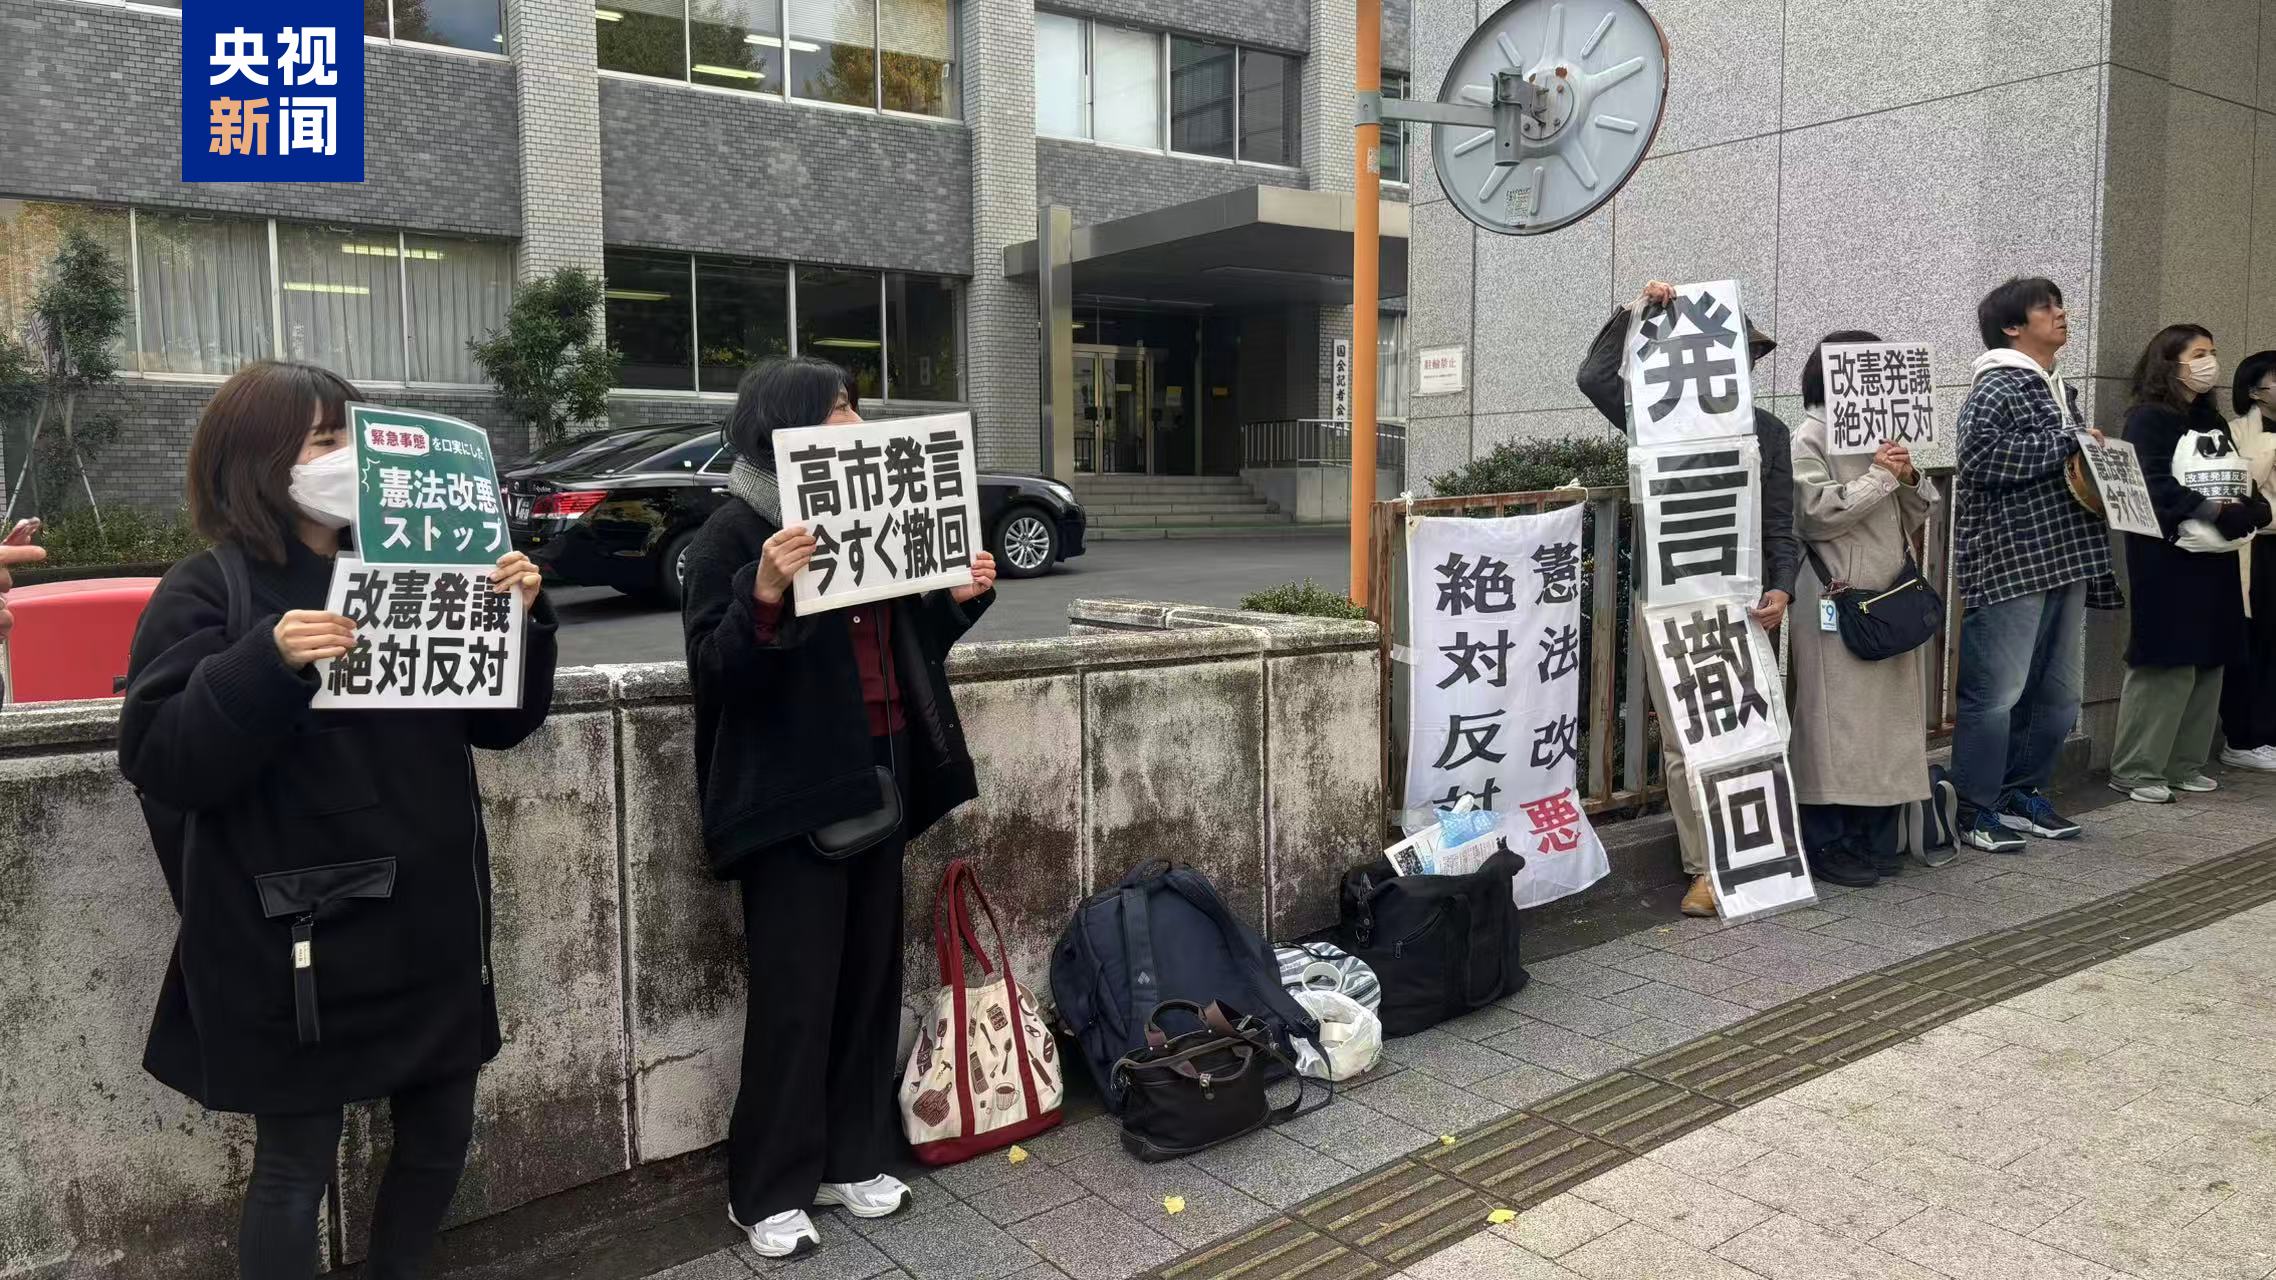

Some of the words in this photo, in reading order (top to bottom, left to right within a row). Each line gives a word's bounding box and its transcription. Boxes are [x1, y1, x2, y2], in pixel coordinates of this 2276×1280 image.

[1336, 344, 1346, 427] 国会記者会
[1829, 348, 1932, 398] 改憲発議
[371, 428, 426, 450] 緊急事態
[432, 437, 485, 461] を口実にした
[1834, 396, 1933, 448] 絶対反対
[379, 466, 499, 513] 憲法改悪
[790, 430, 964, 520] 高市発言
[382, 515, 503, 552] ストップ
[809, 504, 971, 596] 今すぐ撤回
[342, 570, 511, 634] 改憲発議
[1637, 290, 1804, 897] 発言撤回
[1826, 604, 1835, 622] 9
[328, 634, 508, 697] 絶対反対
[1520, 541, 1581, 854] 憲法改悪
